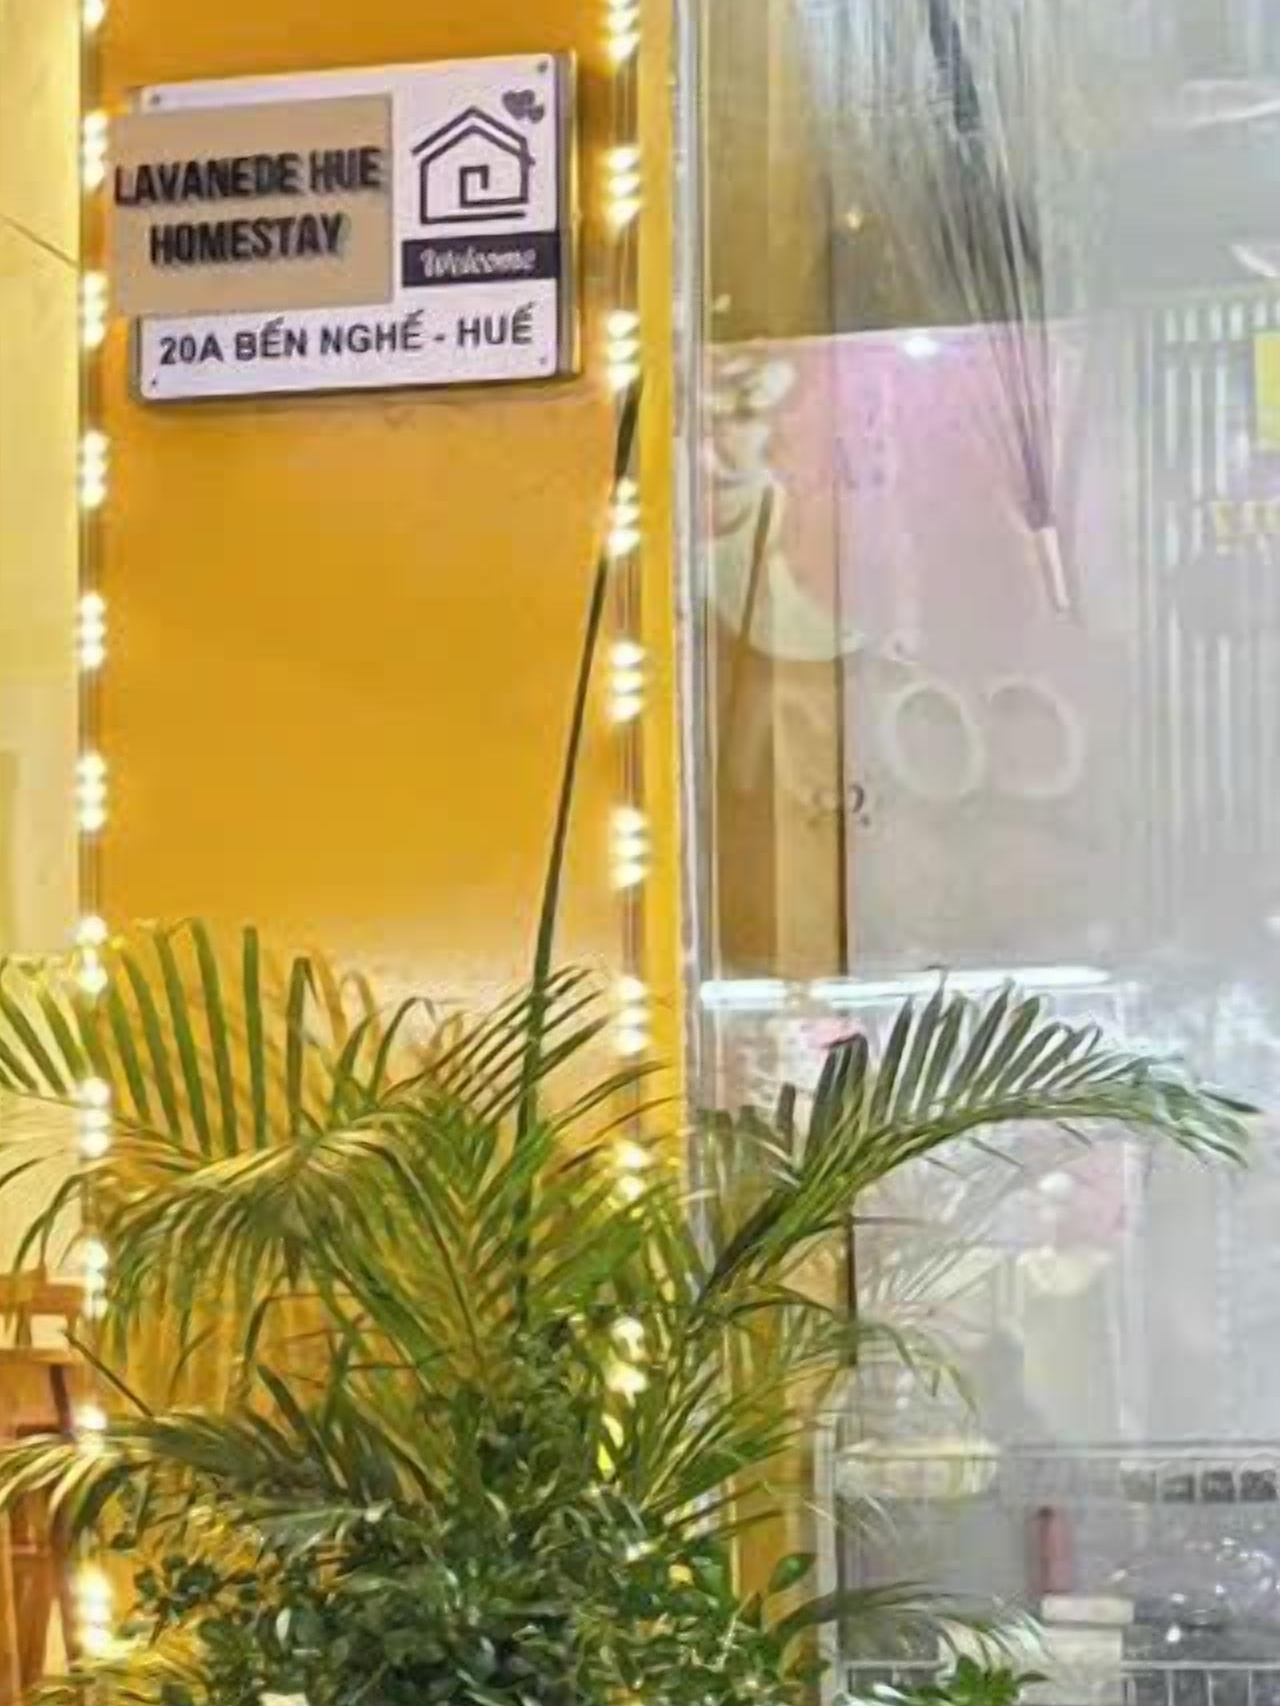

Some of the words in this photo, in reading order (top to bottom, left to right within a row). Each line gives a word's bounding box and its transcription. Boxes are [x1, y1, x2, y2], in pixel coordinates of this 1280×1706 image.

[113, 152, 303, 206] LAVANEDE
[308, 144, 382, 193] HUE
[149, 211, 349, 266] HOMESTAY
[159, 331, 225, 366] 20A
